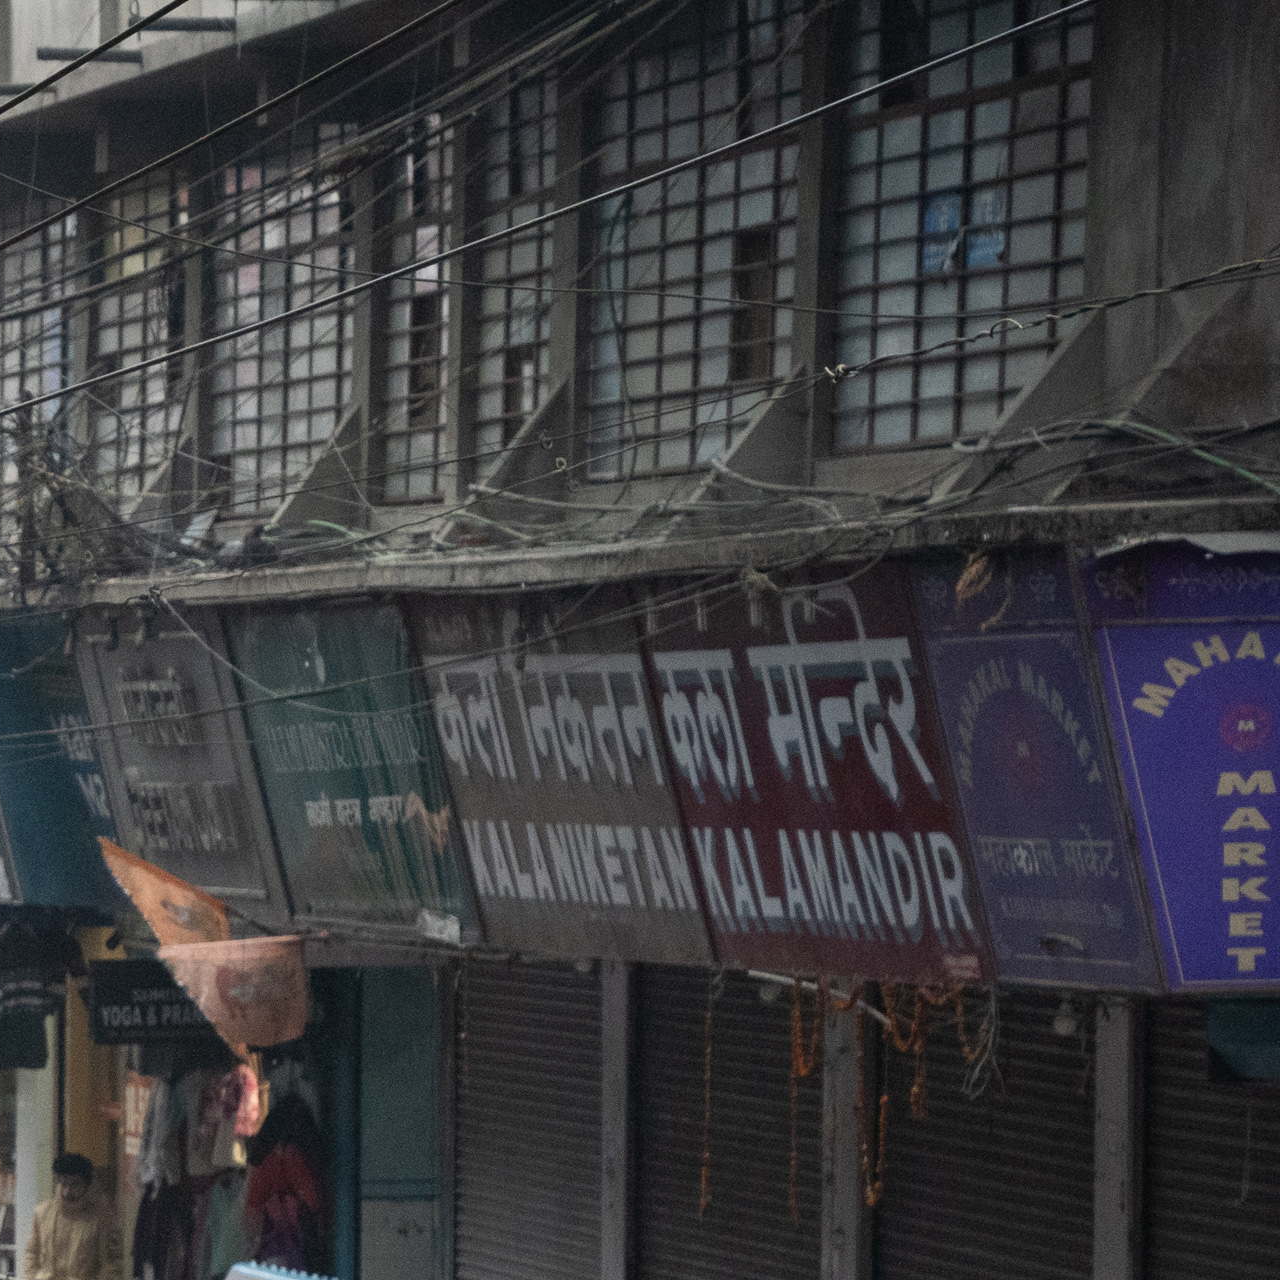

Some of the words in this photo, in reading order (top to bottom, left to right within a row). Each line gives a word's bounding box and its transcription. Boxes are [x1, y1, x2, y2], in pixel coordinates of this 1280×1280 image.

[423, 653, 517, 780] कला
[503, 608, 664, 787] निकेतन
[653, 648, 757, 800] कला
[1132, 631, 1280, 718] MAHA
[692, 827, 975, 934] KALAMANDIR
[1216, 770, 1278, 972] MARKET
